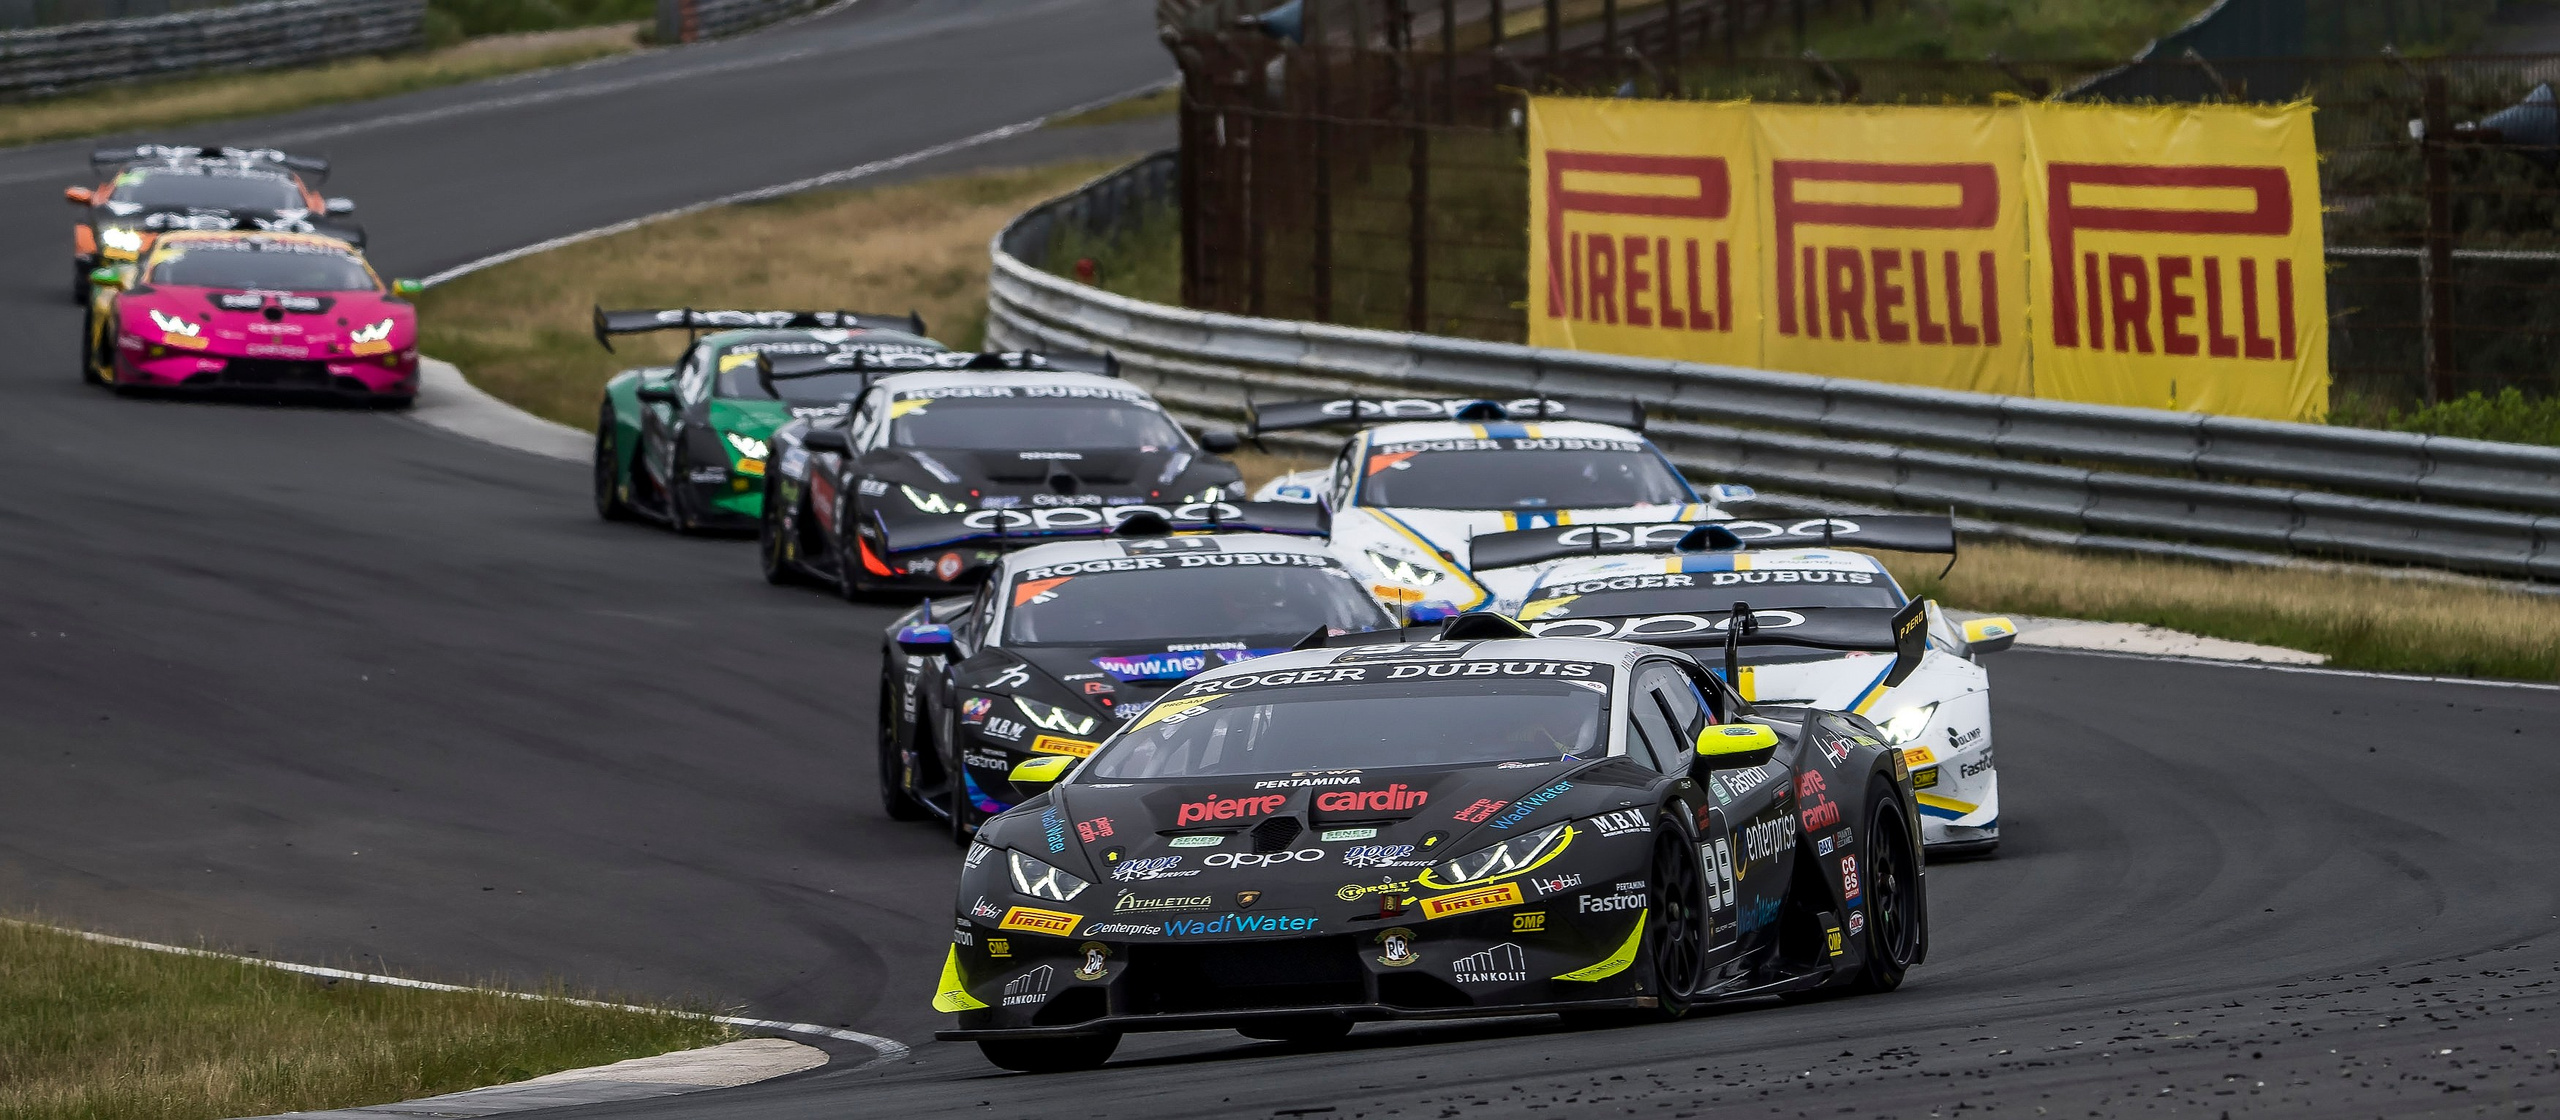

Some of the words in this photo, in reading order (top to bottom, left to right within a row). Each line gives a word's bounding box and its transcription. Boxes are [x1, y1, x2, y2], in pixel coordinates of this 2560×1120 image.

[1546, 150, 1732, 333] PIRELLI
[1772, 159, 2001, 347] PIRELLI
[2048, 161, 2298, 362] PIRELLI
[1383, 438, 1502, 455] ROGER
[1513, 438, 1644, 452] DUBUIS
[1026, 556, 1166, 581] ROGER
[1179, 551, 1328, 569] DUBUIS
[1549, 573, 1696, 599] ROGER
[1711, 570, 1874, 586] DUBUIS
[1529, 609, 1806, 640] ppo
[1167, 641, 1247, 653] PERTAMINA
[1184, 667, 1366, 696] ROGER
[1386, 661, 1595, 680] DUBUIS
[1161, 705, 1210, 726] 99
[1041, 739, 1095, 755] PIRELLI
[1254, 776, 1361, 790] PERTAMINA
[1721, 766, 1770, 797] Fastron
[1177, 793, 1286, 827] pierre
[1316, 783, 1429, 812] cardin
[1453, 798, 1492, 822] pierre
[1469, 800, 1509, 824] cardin
[1489, 780, 1574, 831] WadiWater
[1802, 793, 1841, 833] cardin
[1746, 809, 1797, 864] enterprise
[1203, 848, 1325, 869] oppo
[1346, 844, 1415, 858] DOOR
[1115, 855, 1183, 873] DOOR
[1700, 837, 1735, 913] 99
[1346, 881, 1409, 896] TARGET
[1616, 880, 1646, 892] PERTAMINA
[1431, 887, 1512, 914] PIRELLI
[1579, 893, 1647, 914] Fastron
[1008, 911, 1073, 931] PIRELLI
[1101, 922, 1162, 936] enterprise
[1164, 913, 1319, 937] WadiWater
[1513, 914, 1546, 929] OMP
[988, 941, 1010, 954] OMP
[1828, 932, 1842, 952] OMP
[1456, 971, 1526, 983] STANKOLIT
[1002, 993, 1047, 1007] STANKOLIT
